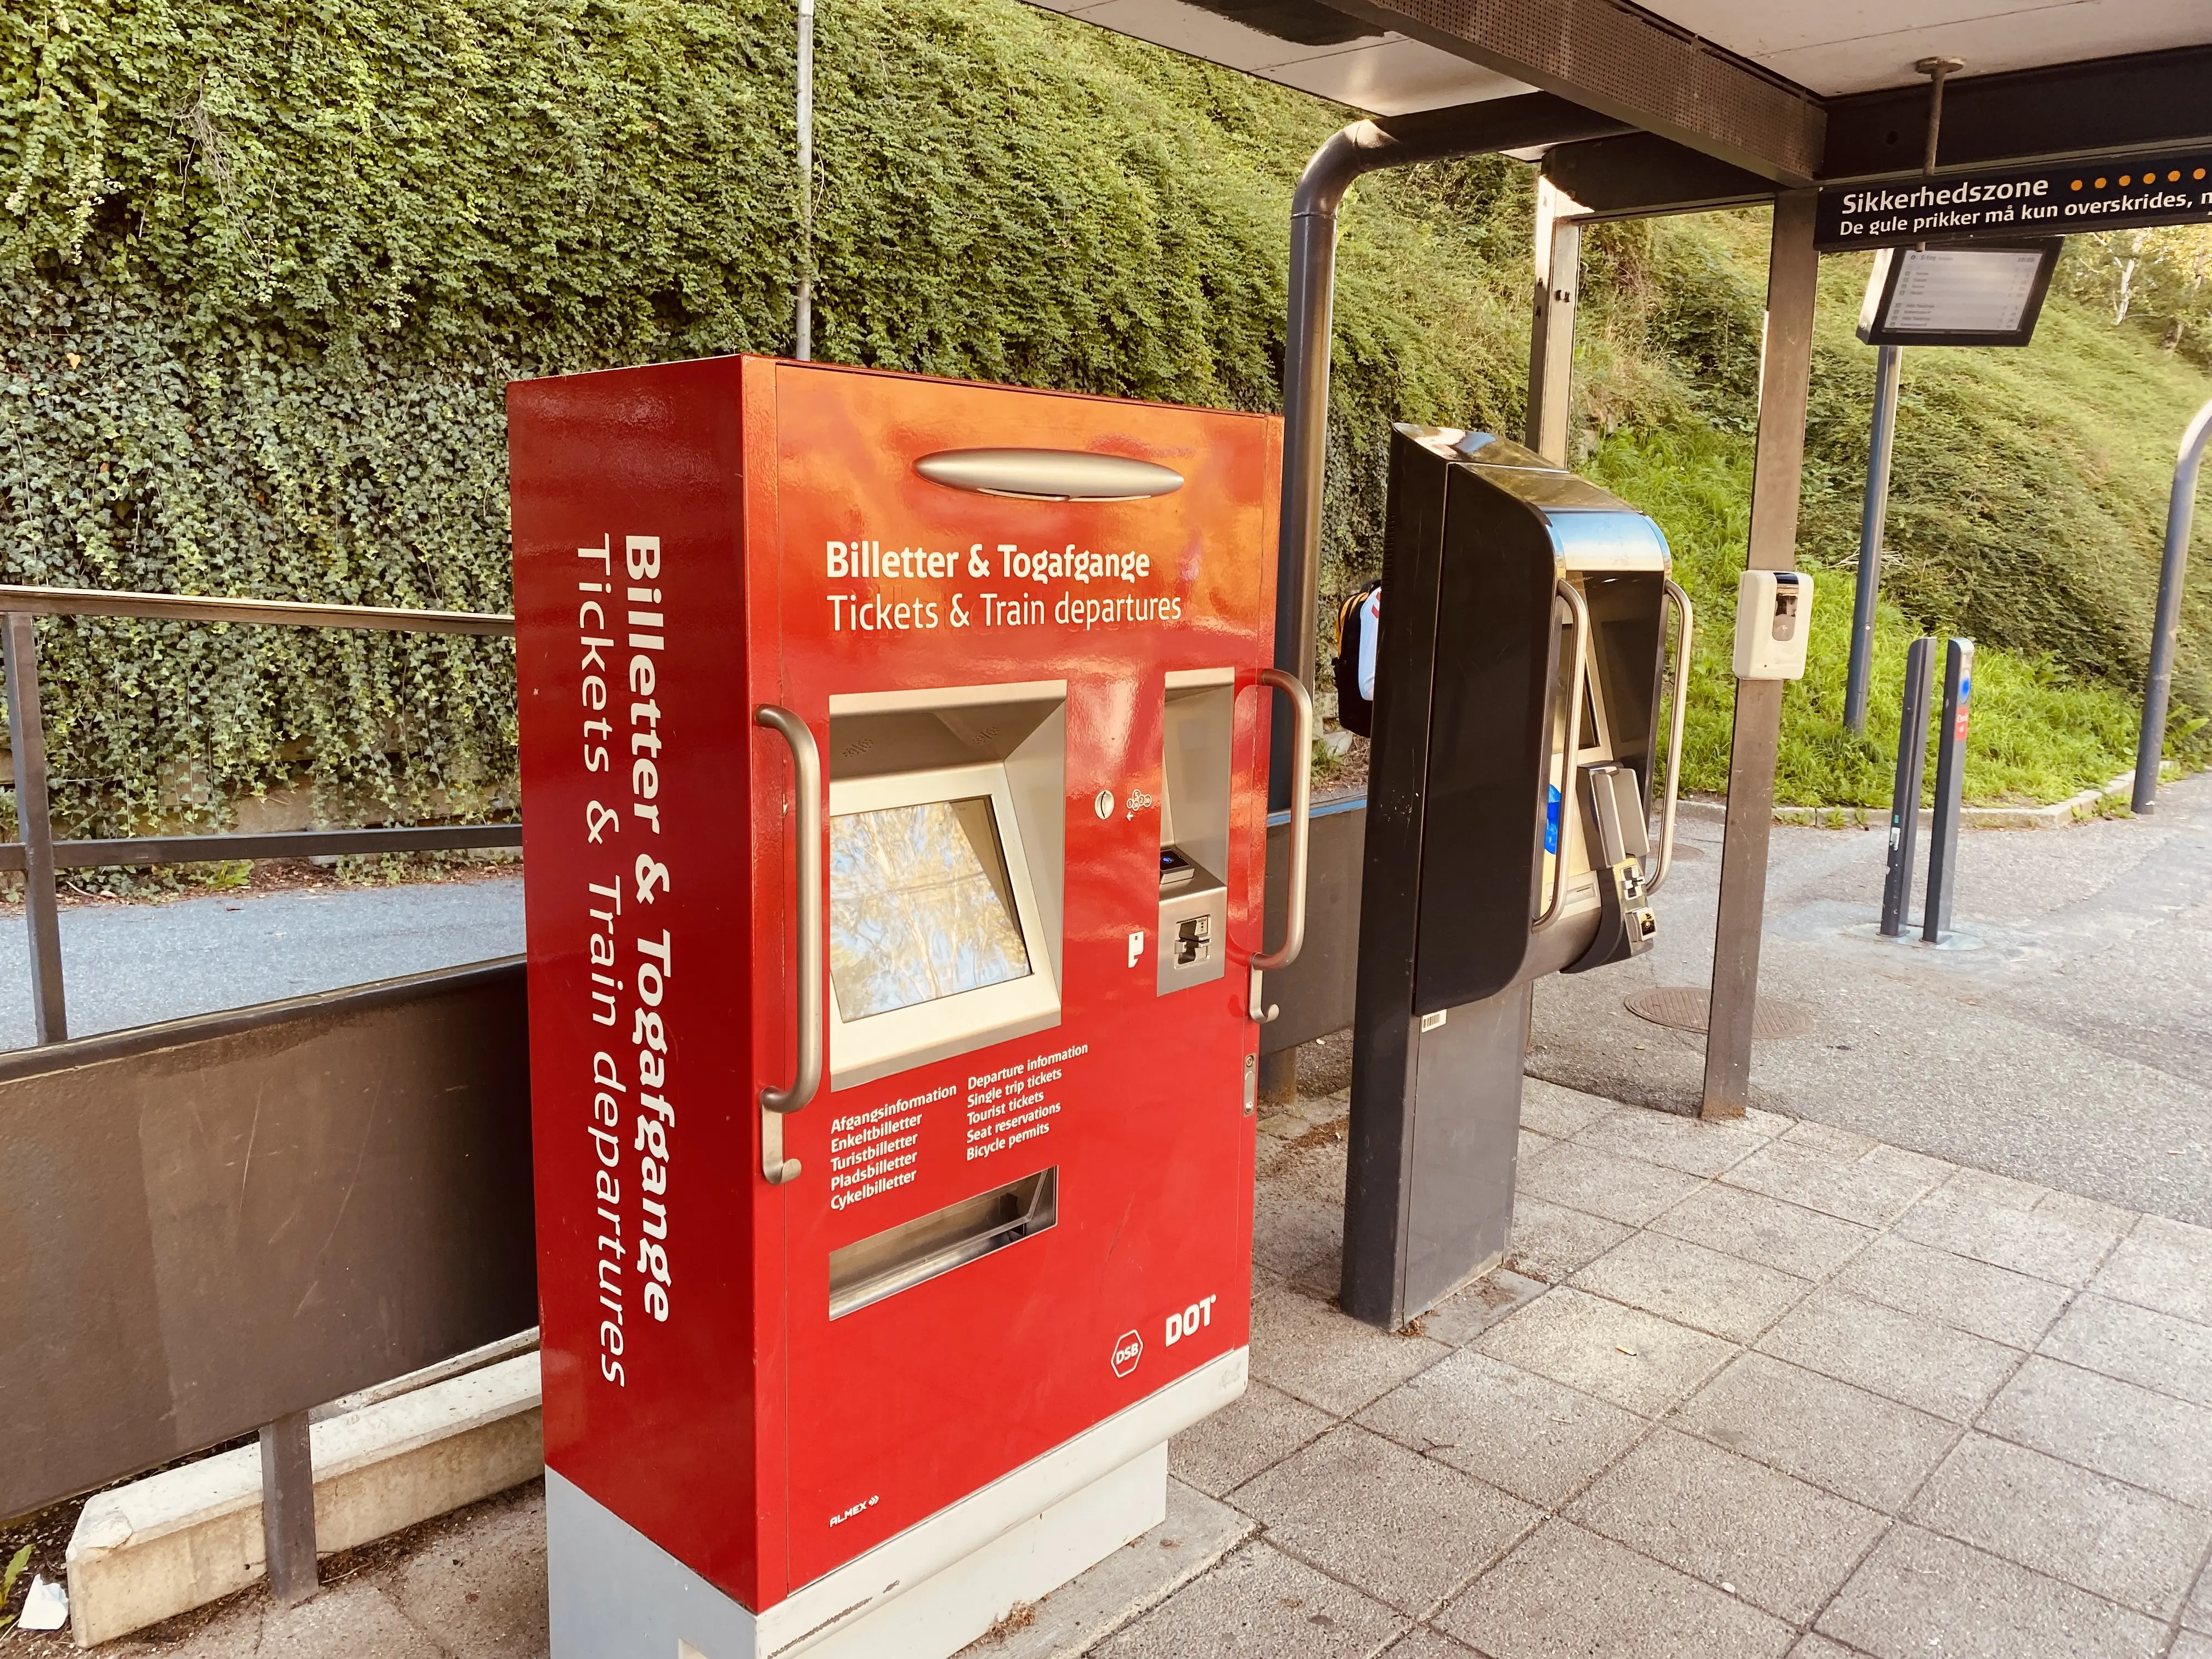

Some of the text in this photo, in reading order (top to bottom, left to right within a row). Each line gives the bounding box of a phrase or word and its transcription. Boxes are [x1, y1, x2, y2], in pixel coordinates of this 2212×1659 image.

[1840, 221, 1864, 235] De
[1869, 216, 1908, 235] gule
[1913, 211, 1980, 233] prikker
[1985, 205, 2014, 223] må
[2021, 204, 2058, 220] kun
[2064, 191, 2193, 216] overskrides,
[1842, 180, 2049, 214] Sikkerhedszone
[827, 540, 1149, 584] Billetter & Togafgange
[827, 591, 1181, 631] Tickets & Train departures
[625, 535, 675, 1322] Billetter & Togafgange
[578, 532, 627, 1387] Tickets & Train departures
[968, 1044, 1088, 1090] Departure information
[967, 1069, 1062, 1108] Single trip tickets
[967, 1091, 1044, 1125] Tourist tickets
[831, 1085, 957, 1135] Afgangsinformation
[967, 1102, 1061, 1144] Seat reservations
[830, 1133, 918, 1172] Turistbilletter
[831, 1114, 923, 1153] Enkeltbilletter
[967, 1123, 1049, 1161] Bicycle permits
[831, 1152, 918, 1192] Pladsbilletter
[831, 1170, 917, 1211] Cykelbilletter
[1165, 1294, 1217, 1347] DOT
[1116, 1342, 1139, 1365] DSB
[830, 1500, 867, 1528] ALMEX
